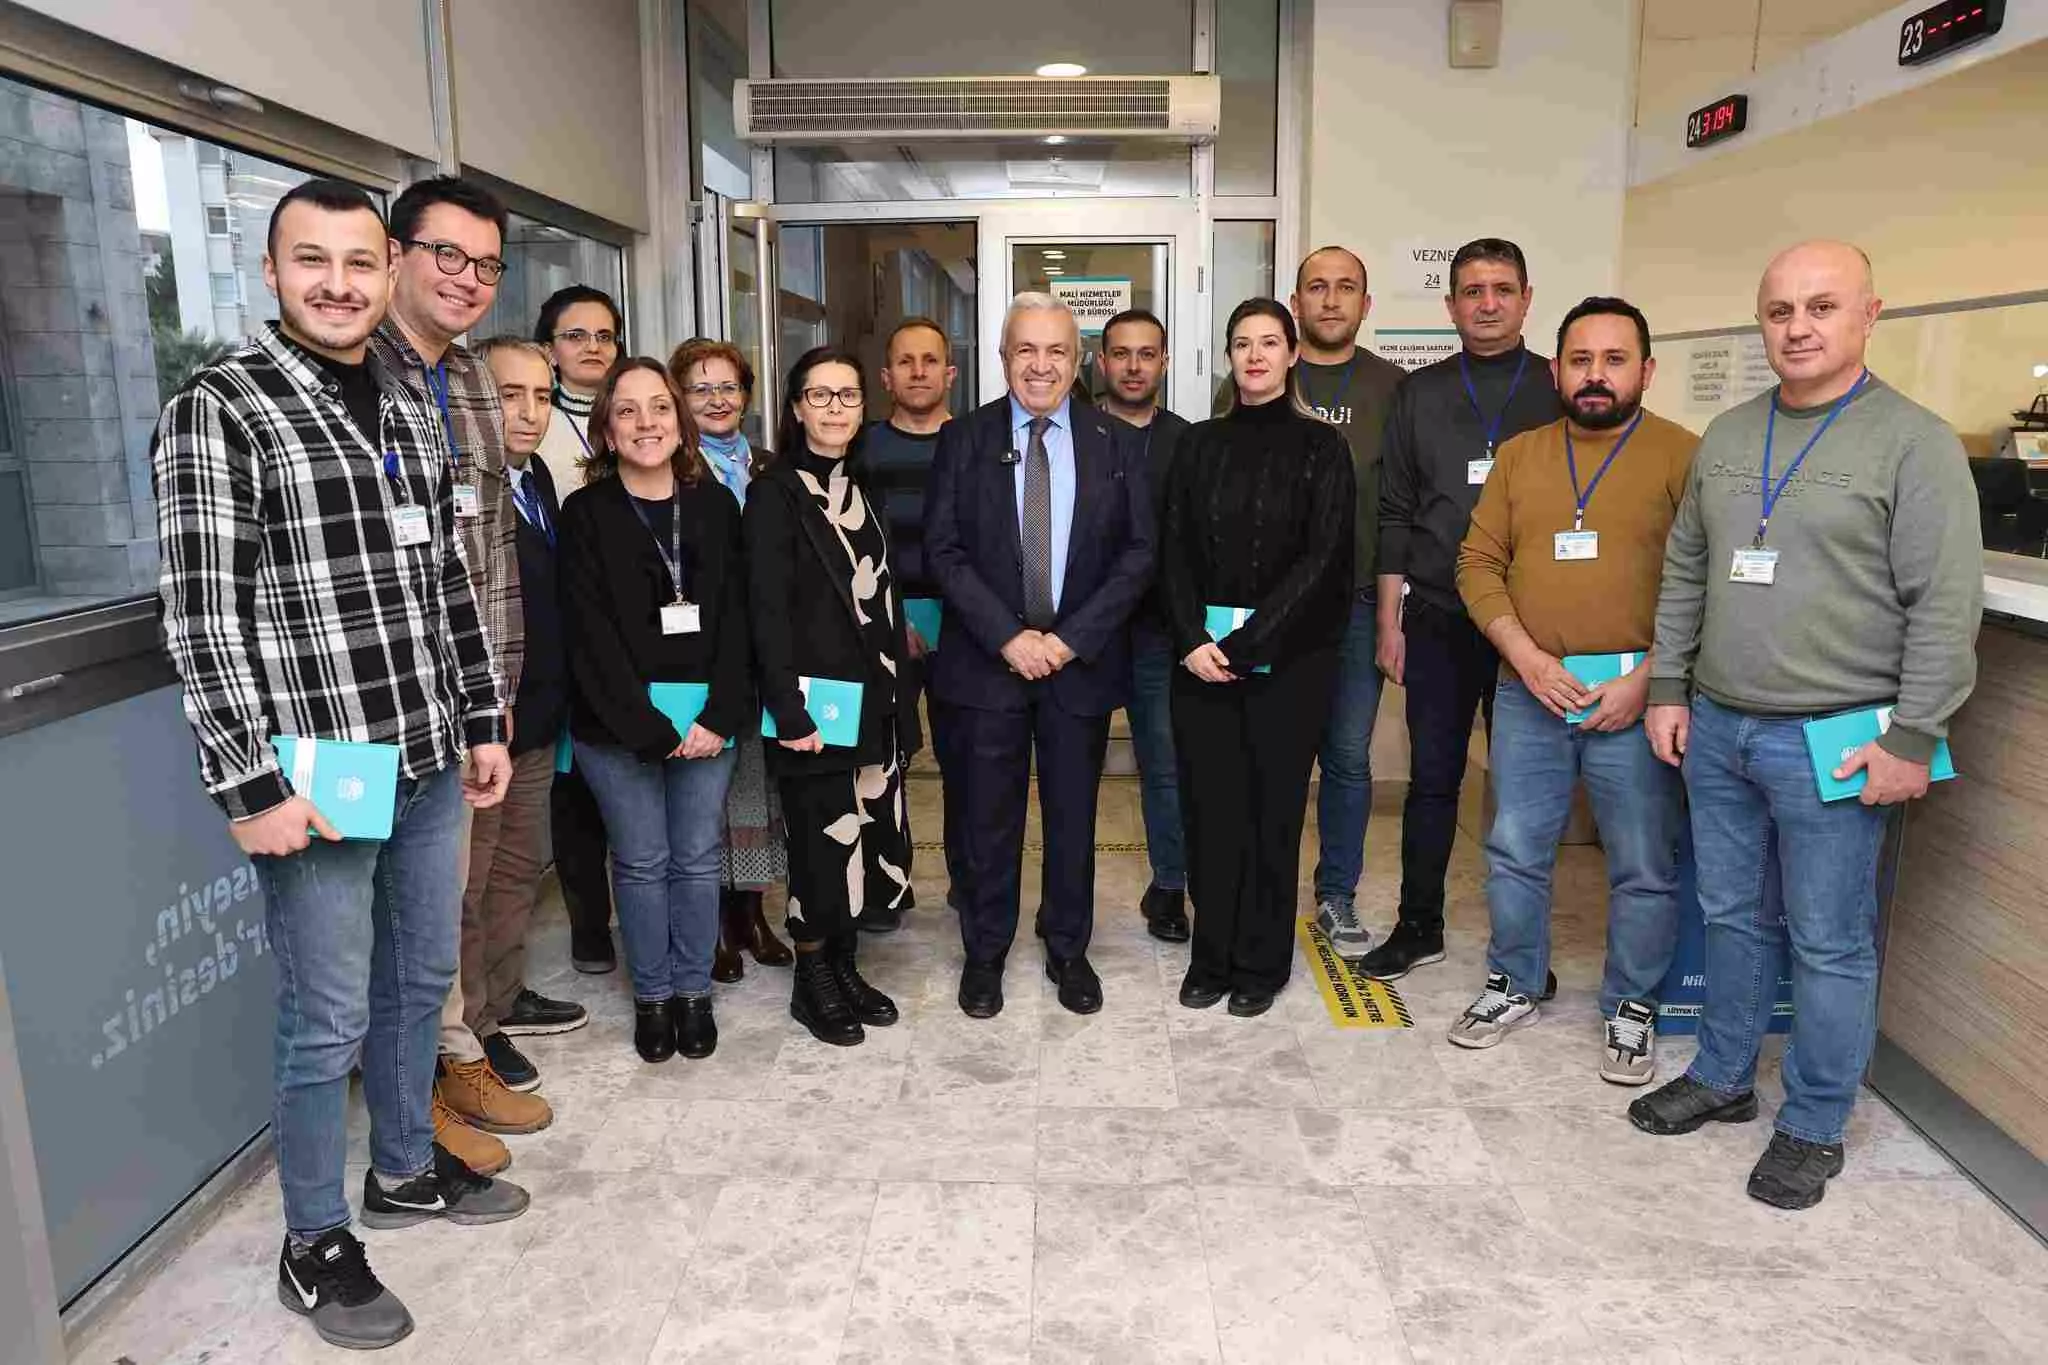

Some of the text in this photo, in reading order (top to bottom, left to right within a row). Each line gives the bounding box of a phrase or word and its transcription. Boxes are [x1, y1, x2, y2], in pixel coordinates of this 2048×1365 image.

[1901, 19, 1924, 57] 23
[1688, 112, 1701, 142] 24
[1413, 249, 1455, 262] VEZNE
[1424, 274, 1441, 287] 24
[1059, 288, 1122, 298] MALİ HİZMETLER
[1067, 298, 1114, 307] MÜDÜRLÜĞÜ
[1087, 308, 1118, 316] BÜROSU
[1362, 998, 1384, 1023] METRE
